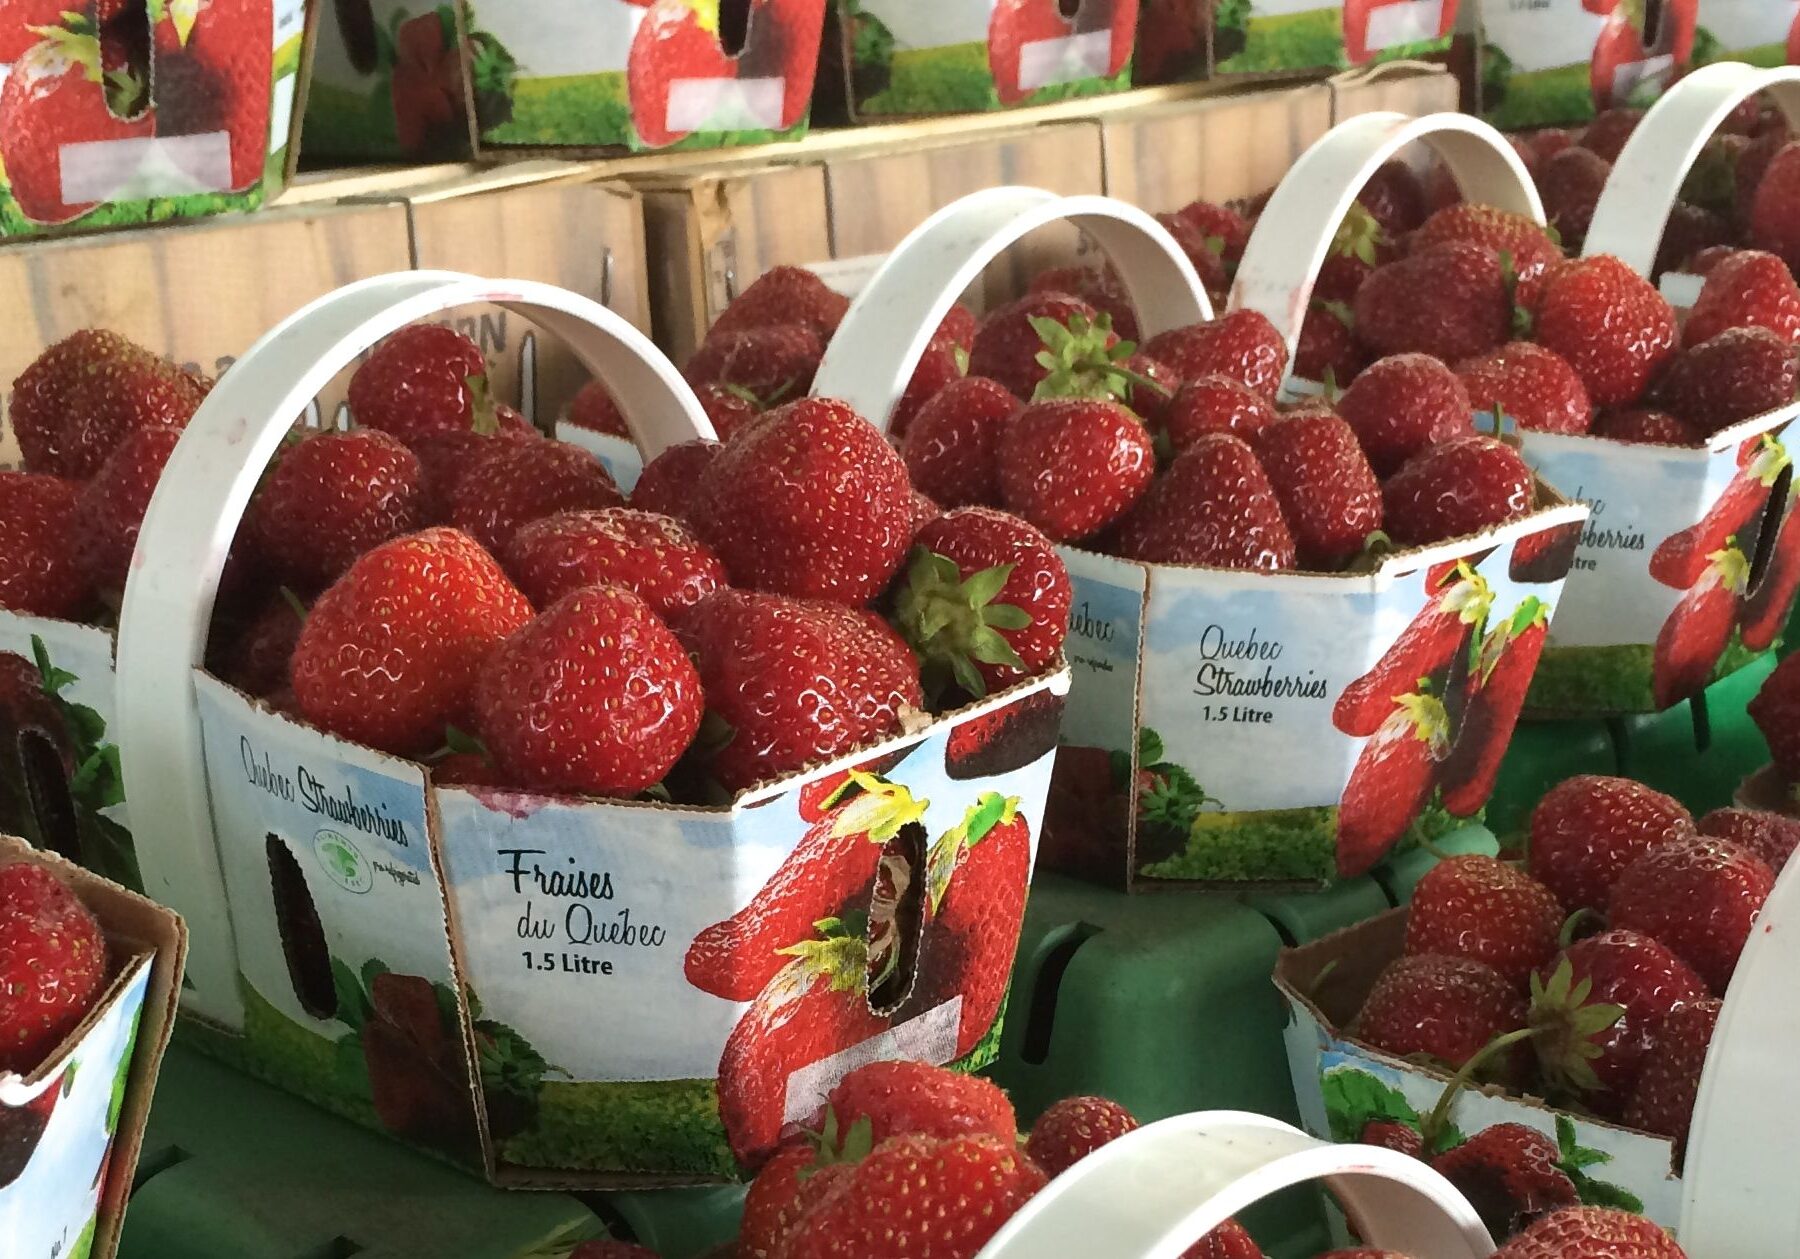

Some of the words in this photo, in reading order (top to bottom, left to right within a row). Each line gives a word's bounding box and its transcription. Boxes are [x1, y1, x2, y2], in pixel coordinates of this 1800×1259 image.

[1200, 624, 1283, 661] Quebec
[1193, 662, 1327, 699] Strawberries
[1202, 705, 1227, 722] 1.5
[1232, 706, 1273, 724] Litre
[240, 735, 295, 803] Quebec
[297, 765, 409, 848] Strawberries
[497, 849, 614, 900] Fraises
[517, 901, 555, 939] du
[565, 903, 666, 946] Québec
[522, 951, 555, 971] 1.5
[562, 953, 613, 975] Litre
